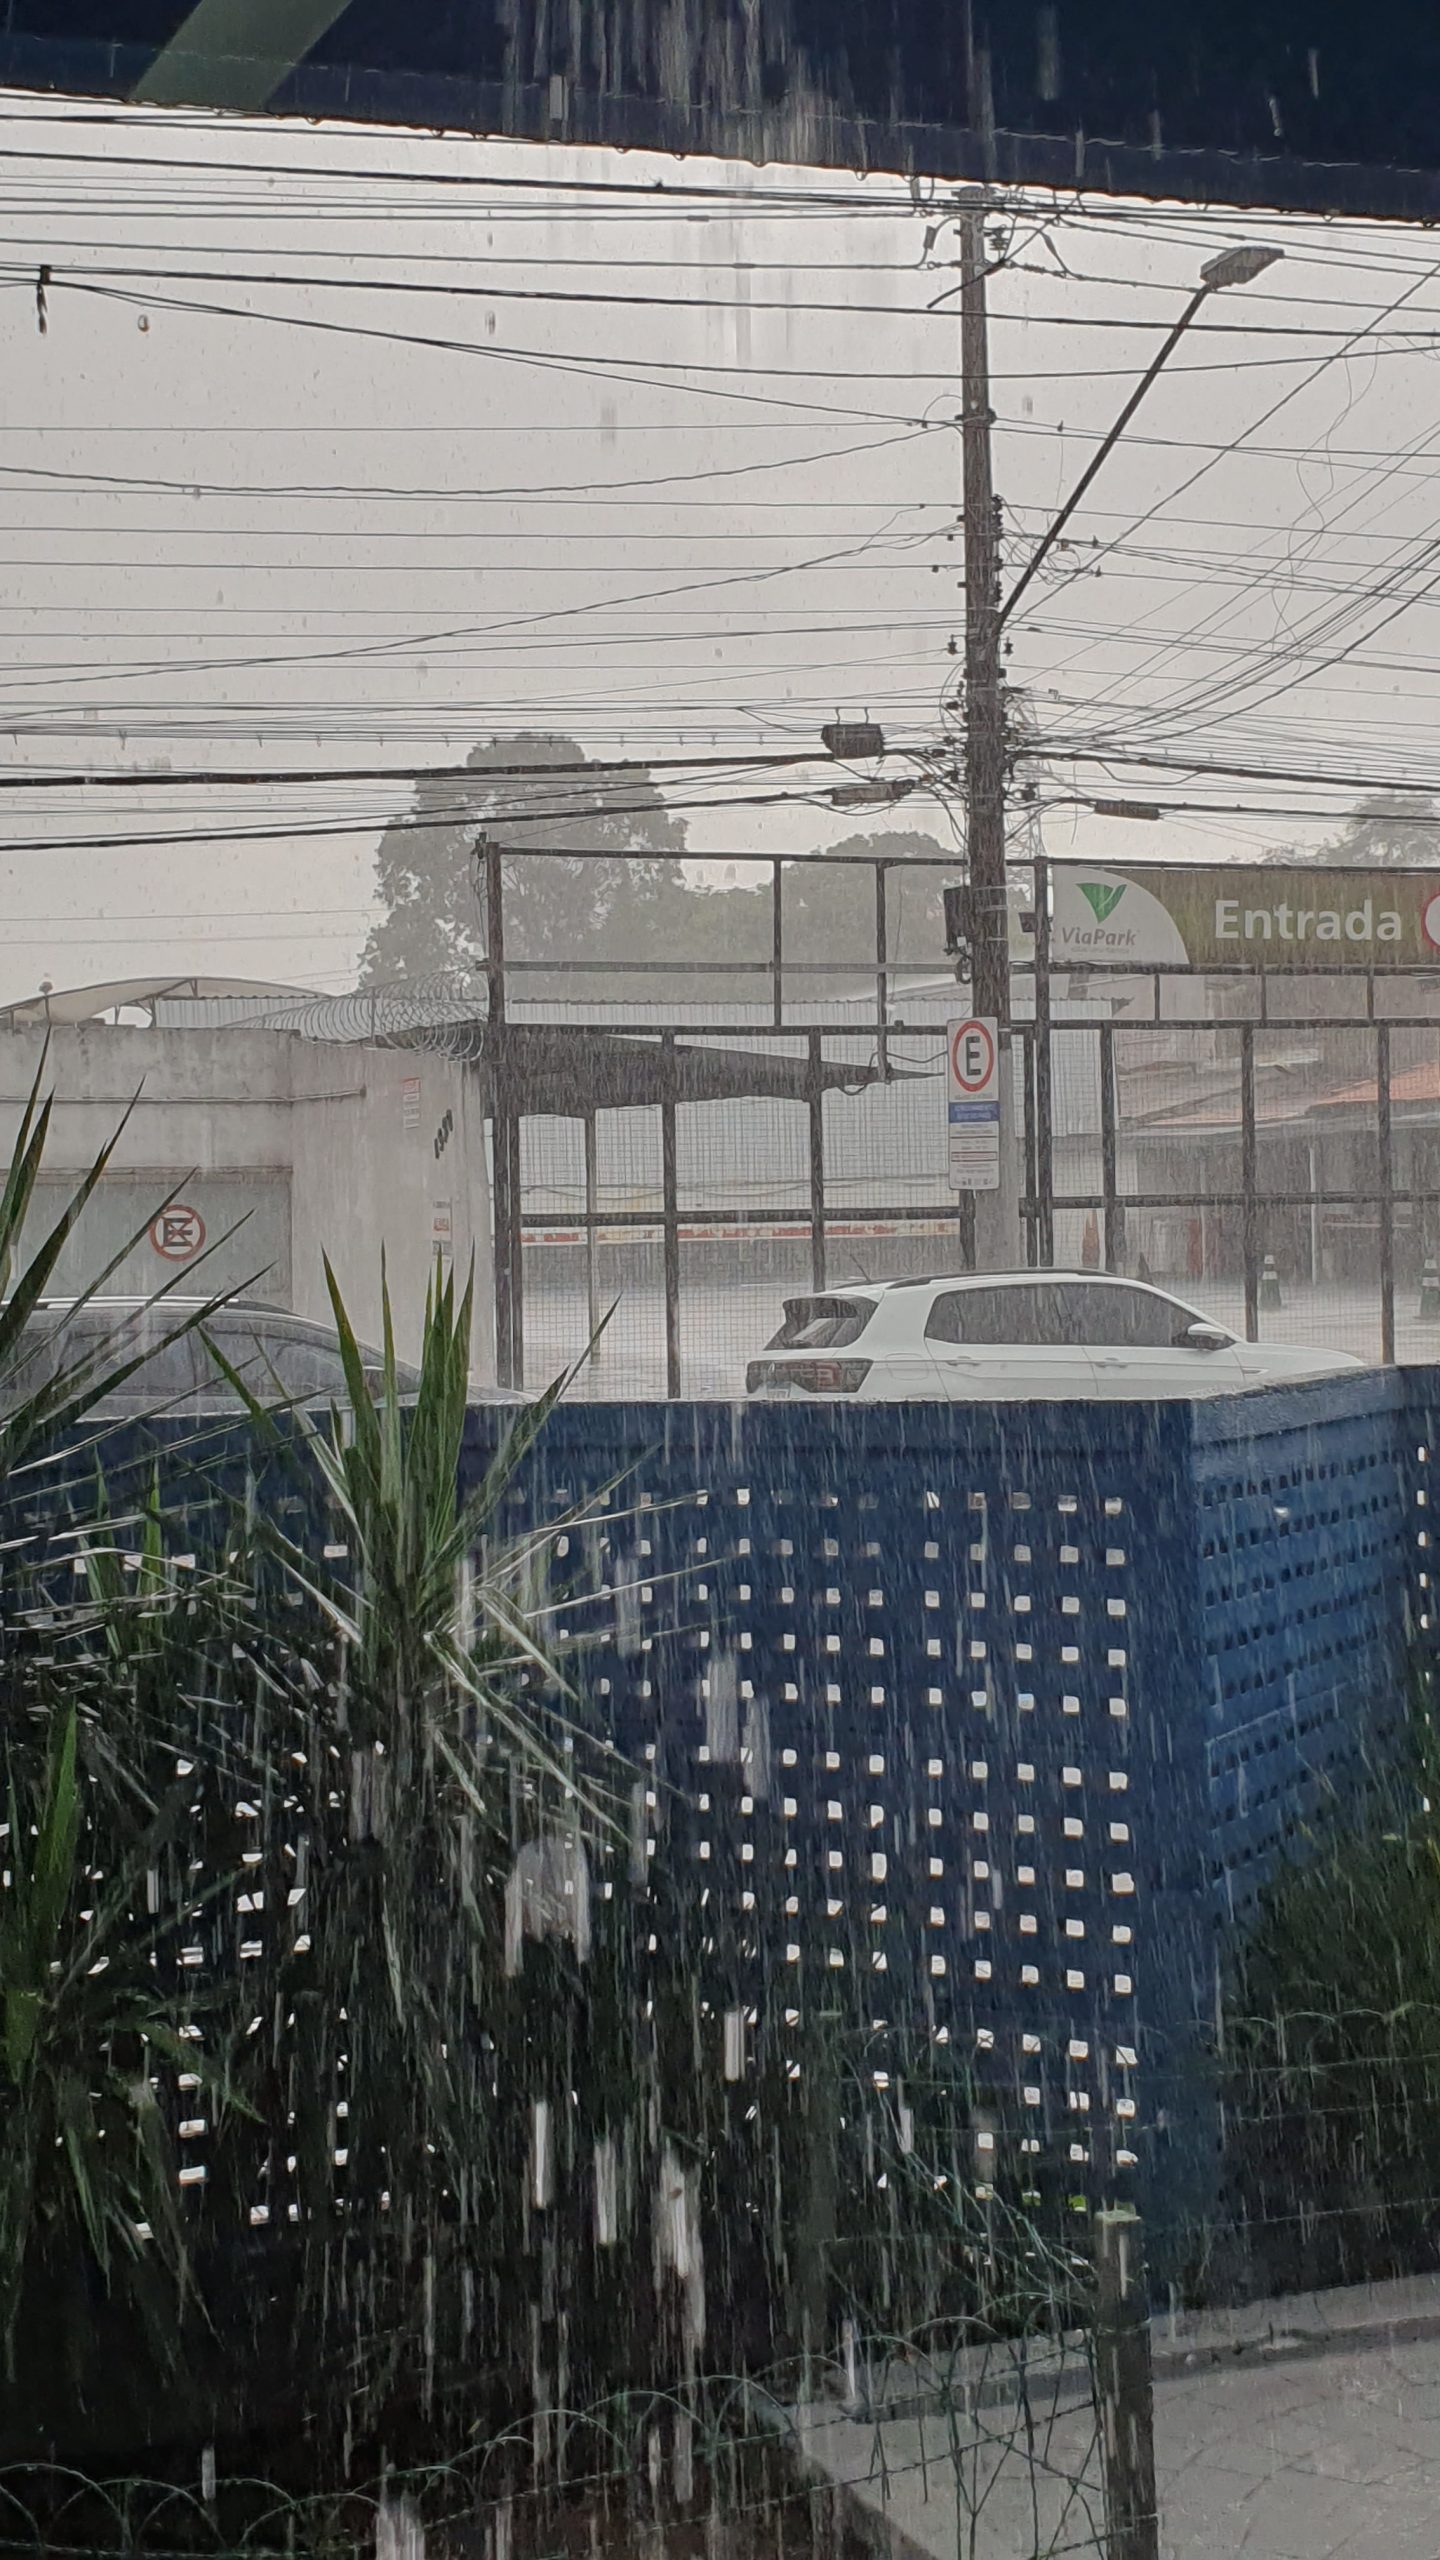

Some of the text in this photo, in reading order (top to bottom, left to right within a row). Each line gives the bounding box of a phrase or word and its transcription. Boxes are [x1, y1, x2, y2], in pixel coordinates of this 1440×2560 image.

[1061, 926, 1137, 946] ViaPark
[1215, 897, 1402, 941] Entrada
[965, 1036, 982, 1077] E
